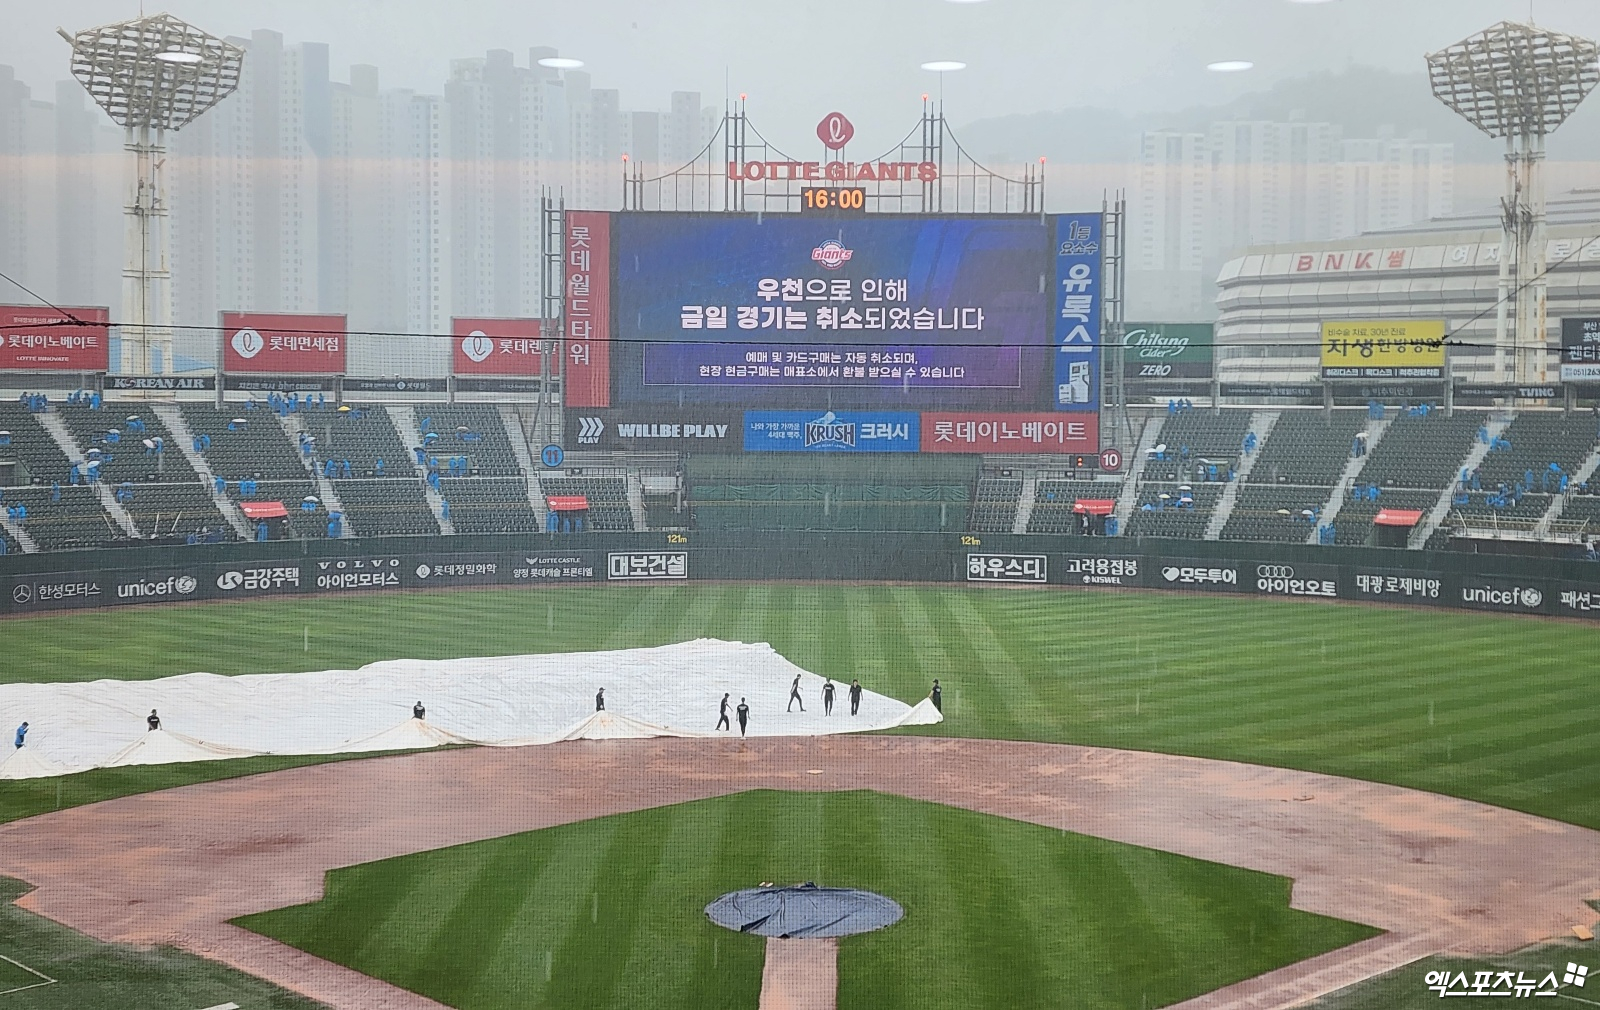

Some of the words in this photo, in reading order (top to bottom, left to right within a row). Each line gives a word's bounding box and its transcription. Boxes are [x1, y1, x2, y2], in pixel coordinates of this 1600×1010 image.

[728, 161, 820, 181] LOTTE
[825, 161, 938, 182] GIANTS
[804, 189, 863, 209] 16:00
[811, 248, 853, 261] Giants
[1059, 240, 1098, 255] 요소수
[570, 226, 593, 366] 롯데월드타워
[757, 278, 853, 302] 우천으로
[860, 278, 908, 303] 인해
[1061, 263, 1093, 353] 유록스
[680, 305, 728, 330] 금일
[736, 306, 808, 330] 경기는
[815, 306, 985, 331] 취소되었습니다
[8, 334, 99, 349] 롯데이노베이트
[269, 335, 339, 352] 롯데면세점
[745, 352, 768, 364] 예매
[771, 352, 783, 364] 및
[786, 352, 842, 365] 카드구매는
[844, 353, 868, 365] 자동
[870, 352, 919, 365] 취소되며,
[699, 365, 721, 377] 현장
[725, 365, 781, 378] 현금구매는
[784, 366, 839, 378] 매표소에서
[842, 366, 865, 378] 환불
[868, 366, 902, 379] 받으실
[905, 367, 917, 378] 수
[919, 367, 965, 379] 있습니다
[1139, 365, 1172, 377] ZERO
[114, 378, 173, 390] KOREAN
[178, 378, 205, 389] AIR
[617, 424, 681, 438] WILLBE
[684, 424, 728, 438] PLAY
[805, 422, 855, 448] KRUSH
[860, 422, 909, 440] 크러시
[933, 421, 1088, 444] 롯데이노베이트
[577, 436, 599, 444] PLAY
[546, 450, 559, 463] 11
[1102, 453, 1119, 467] 10
[667, 534, 687, 544] 121m
[960, 535, 981, 546] 121m
[317, 559, 400, 570] VOLVO
[433, 563, 497, 577] 롯데정밀화학
[513, 568, 529, 579] 양정
[530, 567, 562, 578] 롯데캐슬
[611, 554, 685, 577] 대보건설
[969, 557, 1041, 578] 하우스디
[1066, 559, 1138, 577] 고려용접봉
[244, 567, 299, 590] 금강주택
[317, 572, 400, 589] 아이언모터스
[1091, 576, 1122, 585] KISWEL
[1180, 567, 1237, 584] 모두투어
[39, 582, 102, 600] 한성모터스
[117, 576, 176, 598] unicef
[1257, 578, 1337, 597] 아이언오토
[1463, 585, 1520, 605] unicef
